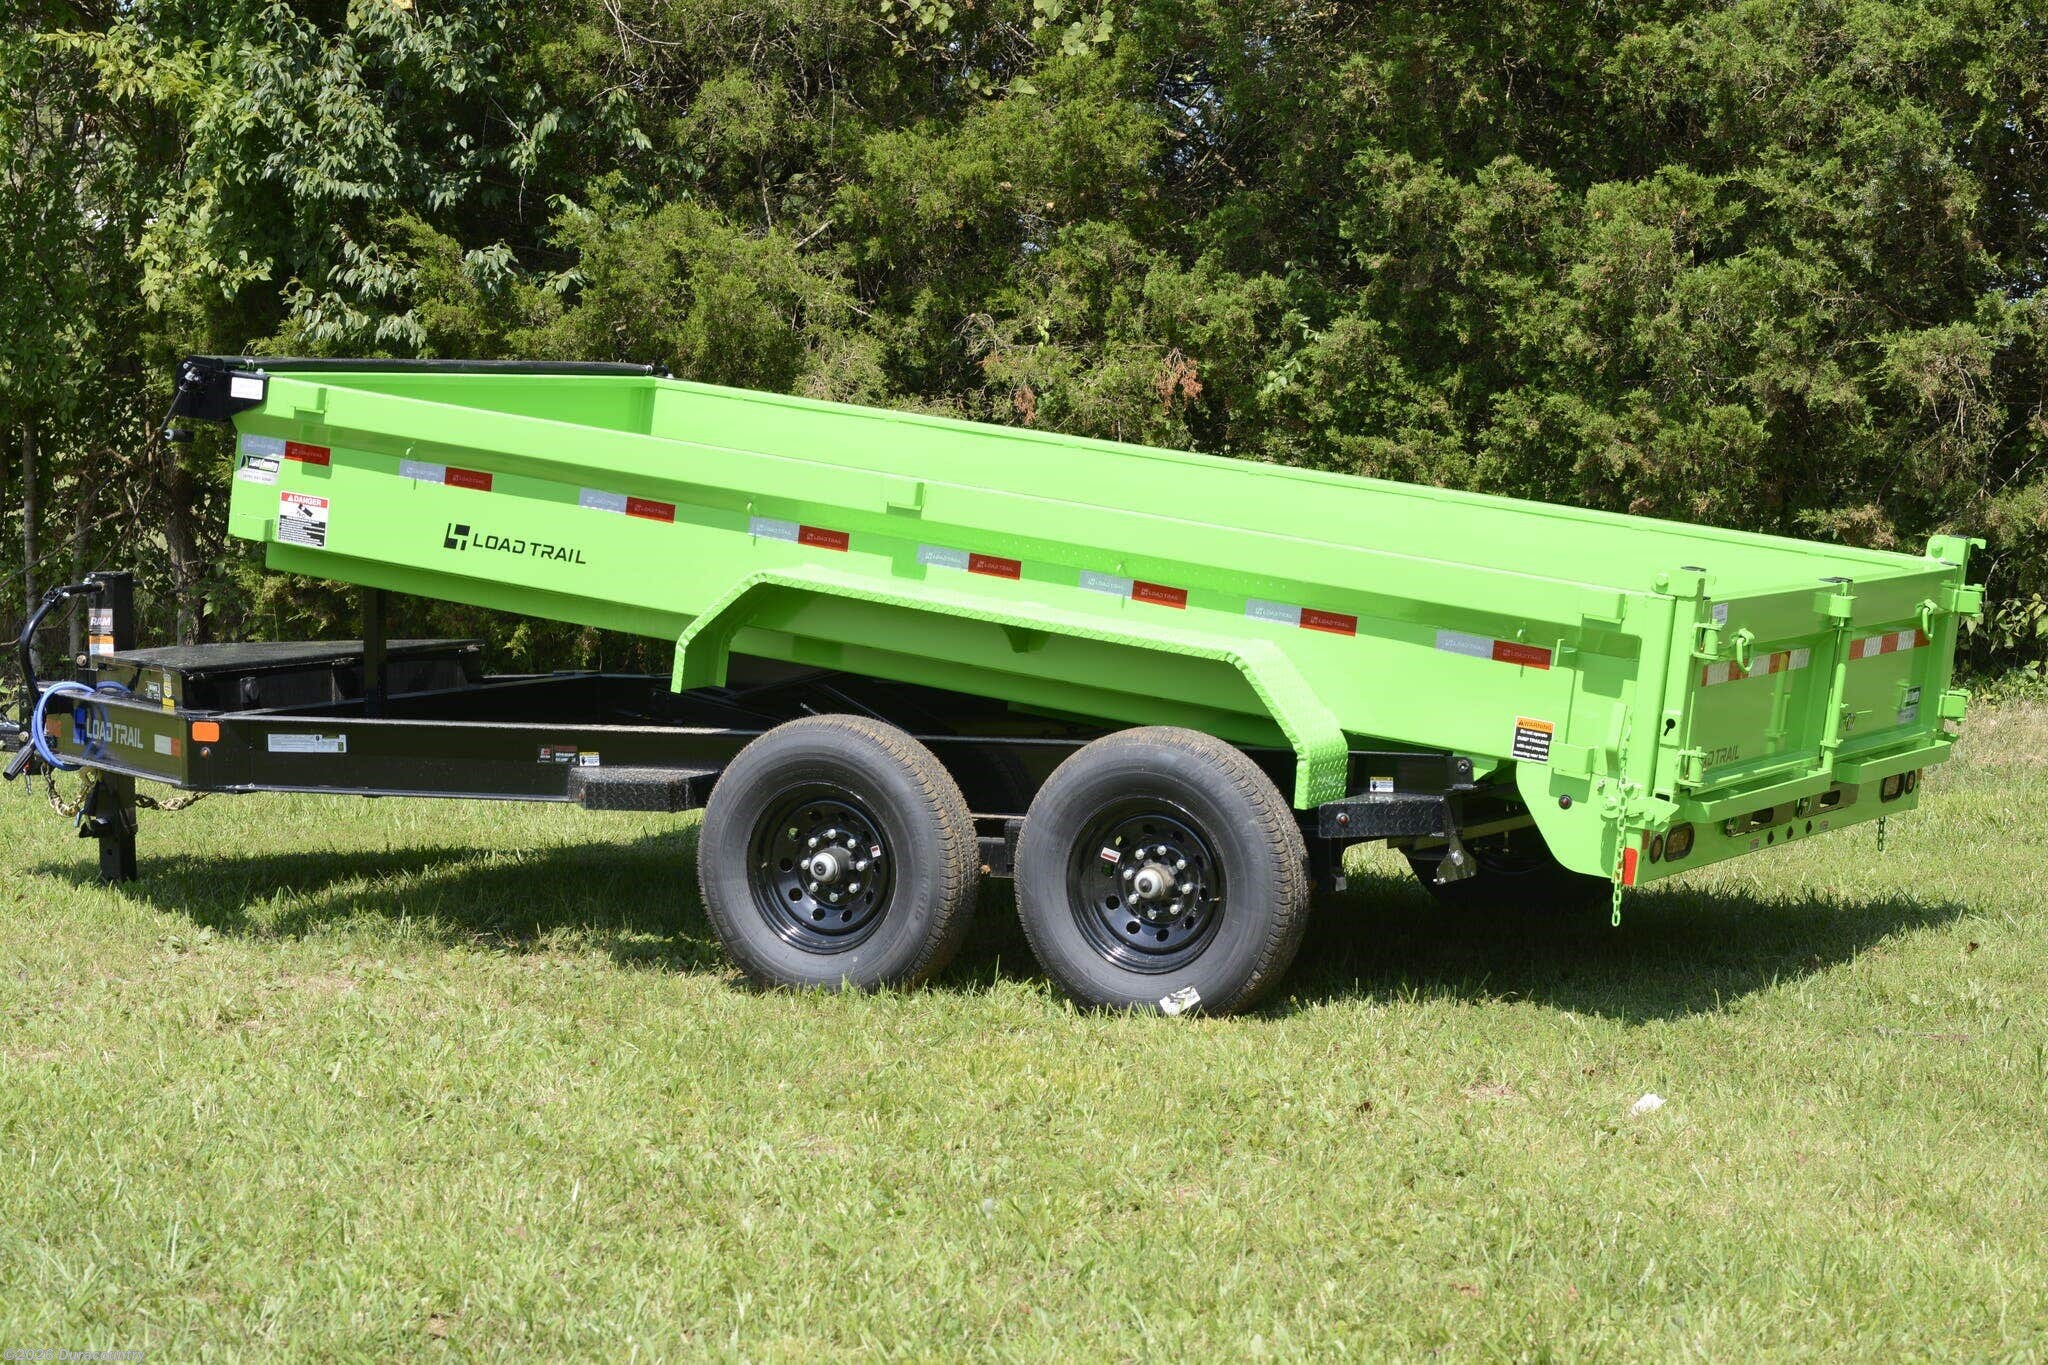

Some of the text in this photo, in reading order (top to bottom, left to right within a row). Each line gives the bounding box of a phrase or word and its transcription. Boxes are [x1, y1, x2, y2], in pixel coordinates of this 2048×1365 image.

[293, 495, 321, 505] DANGER
[473, 533, 587, 565] LOAD TRAIL
[90, 616, 111, 626] RAM
[86, 718, 144, 749] LOAD TRAIL
[1523, 721, 1552, 731] WARNING
[1716, 744, 1740, 765] TRAIL
